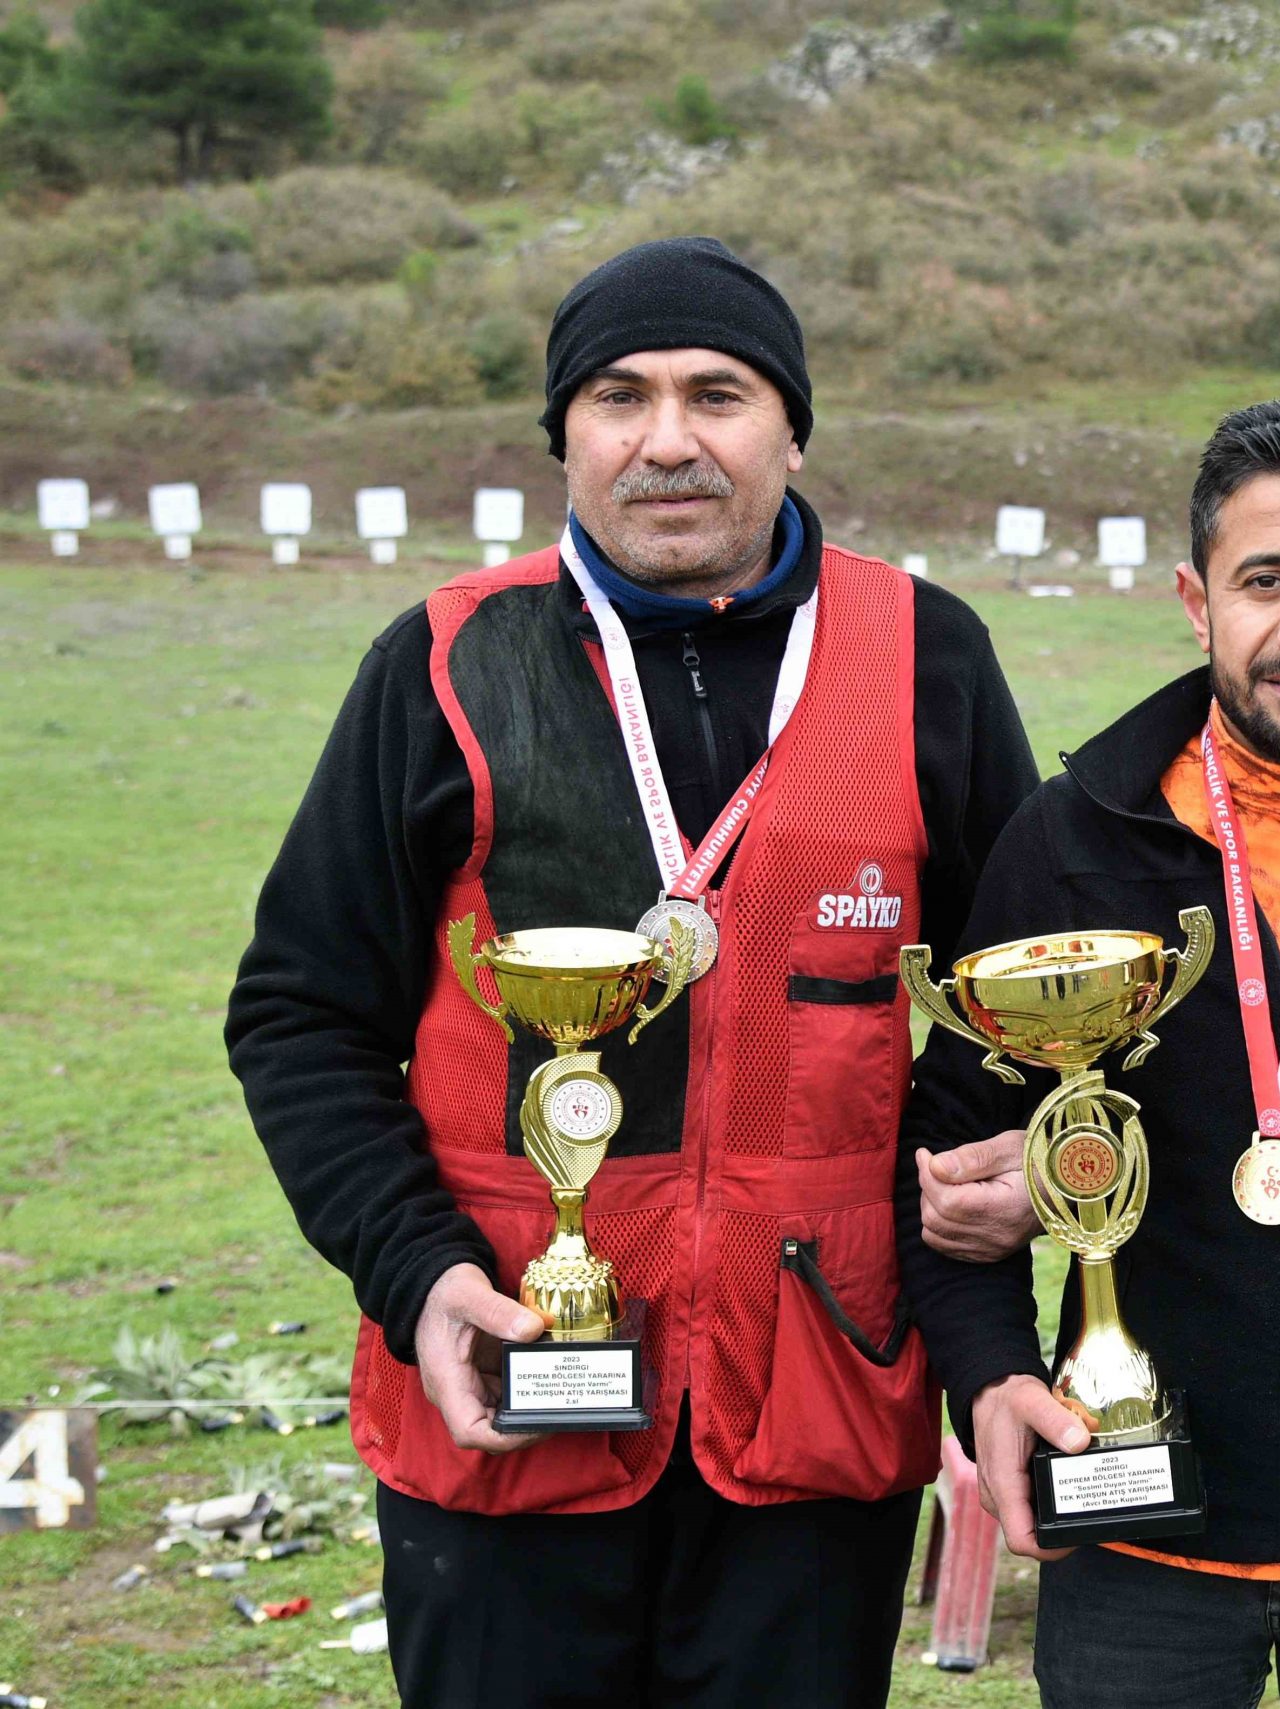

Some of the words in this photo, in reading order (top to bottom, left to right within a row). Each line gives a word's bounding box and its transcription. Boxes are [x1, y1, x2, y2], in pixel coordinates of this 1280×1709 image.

[1204, 738, 1224, 797] GENÇLİK
[1215, 799, 1229, 818] VE
[681, 798, 749, 895] CUMHURİYETİ
[1220, 820, 1237, 860] SPOR
[818, 894, 901, 928] SPAYKO
[1230, 864, 1252, 950] BAKANLIĞI
[0, 1409, 85, 1528] 4
[1058, 1475, 1091, 1485] DEPREM
[1127, 1467, 1165, 1477] YARARINA
[1103, 1481, 1127, 1489] Duyan
[1076, 1491, 1107, 1500] KURŞUN
[1109, 1488, 1126, 1496] ATIŞ
[1128, 1484, 1169, 1494] YARIŞMASI
[1102, 1498, 1119, 1506] Başı
